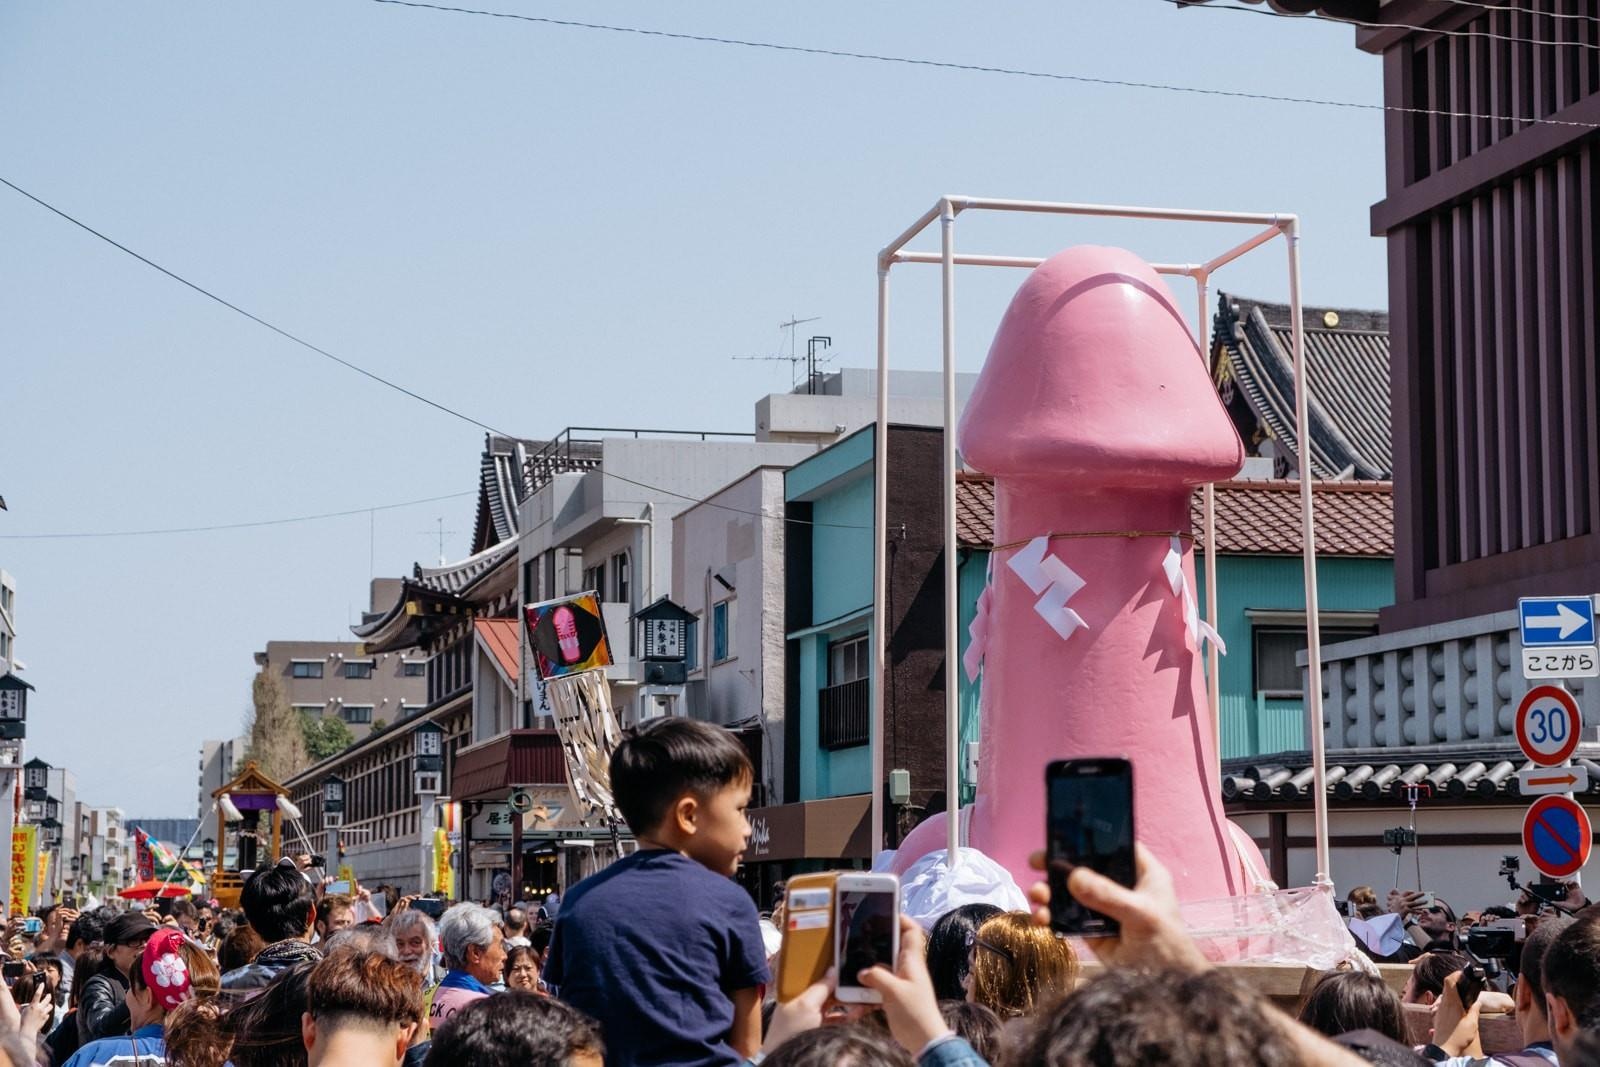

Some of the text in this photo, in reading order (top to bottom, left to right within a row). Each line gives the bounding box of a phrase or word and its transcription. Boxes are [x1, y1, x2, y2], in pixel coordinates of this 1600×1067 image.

[1528, 654, 1593, 671] ここから
[1530, 707, 1566, 743] 30
